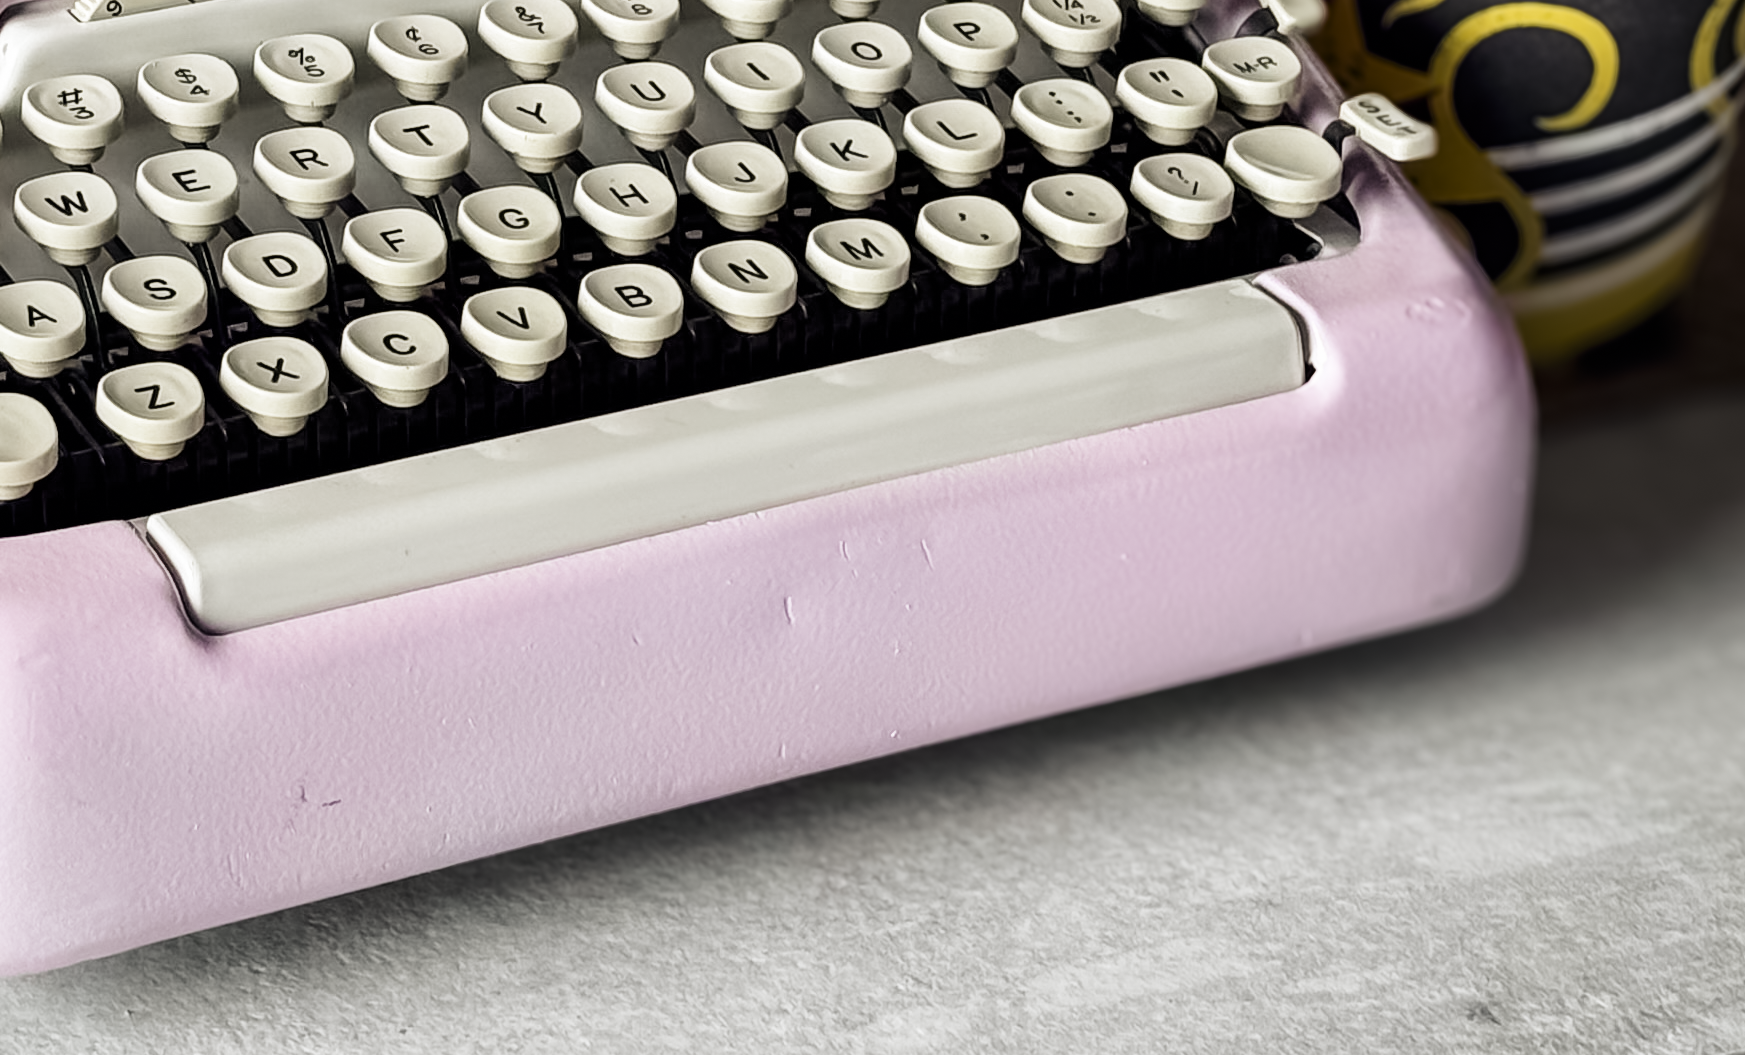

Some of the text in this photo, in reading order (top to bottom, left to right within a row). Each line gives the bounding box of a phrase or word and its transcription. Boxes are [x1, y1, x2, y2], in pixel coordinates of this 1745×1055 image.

[953, 22, 980, 41] P
[851, 42, 883, 61] O
[746, 62, 770, 80] I
[57, 88, 83, 107] #
[631, 81, 666, 101] U
[69, 106, 95, 119] 3
[517, 102, 547, 124] Y
[1359, 100, 1417, 135] SET
[403, 125, 433, 146] T
[936, 121, 977, 140] L
[289, 149, 329, 170] R
[829, 139, 868, 161] K
[171, 170, 211, 192] E
[734, 162, 758, 183] J
[45, 191, 89, 217] W
[609, 183, 648, 206] H
[498, 208, 529, 229] G
[380, 228, 405, 252] F
[839, 238, 884, 260] M
[261, 254, 297, 278] D
[727, 259, 769, 283] N
[143, 279, 176, 300] S
[614, 285, 653, 308] B
[27, 305, 57, 326] A
[496, 307, 529, 330] V
[382, 334, 417, 355] C
[256, 358, 300, 383] X
[134, 385, 175, 410] Z
